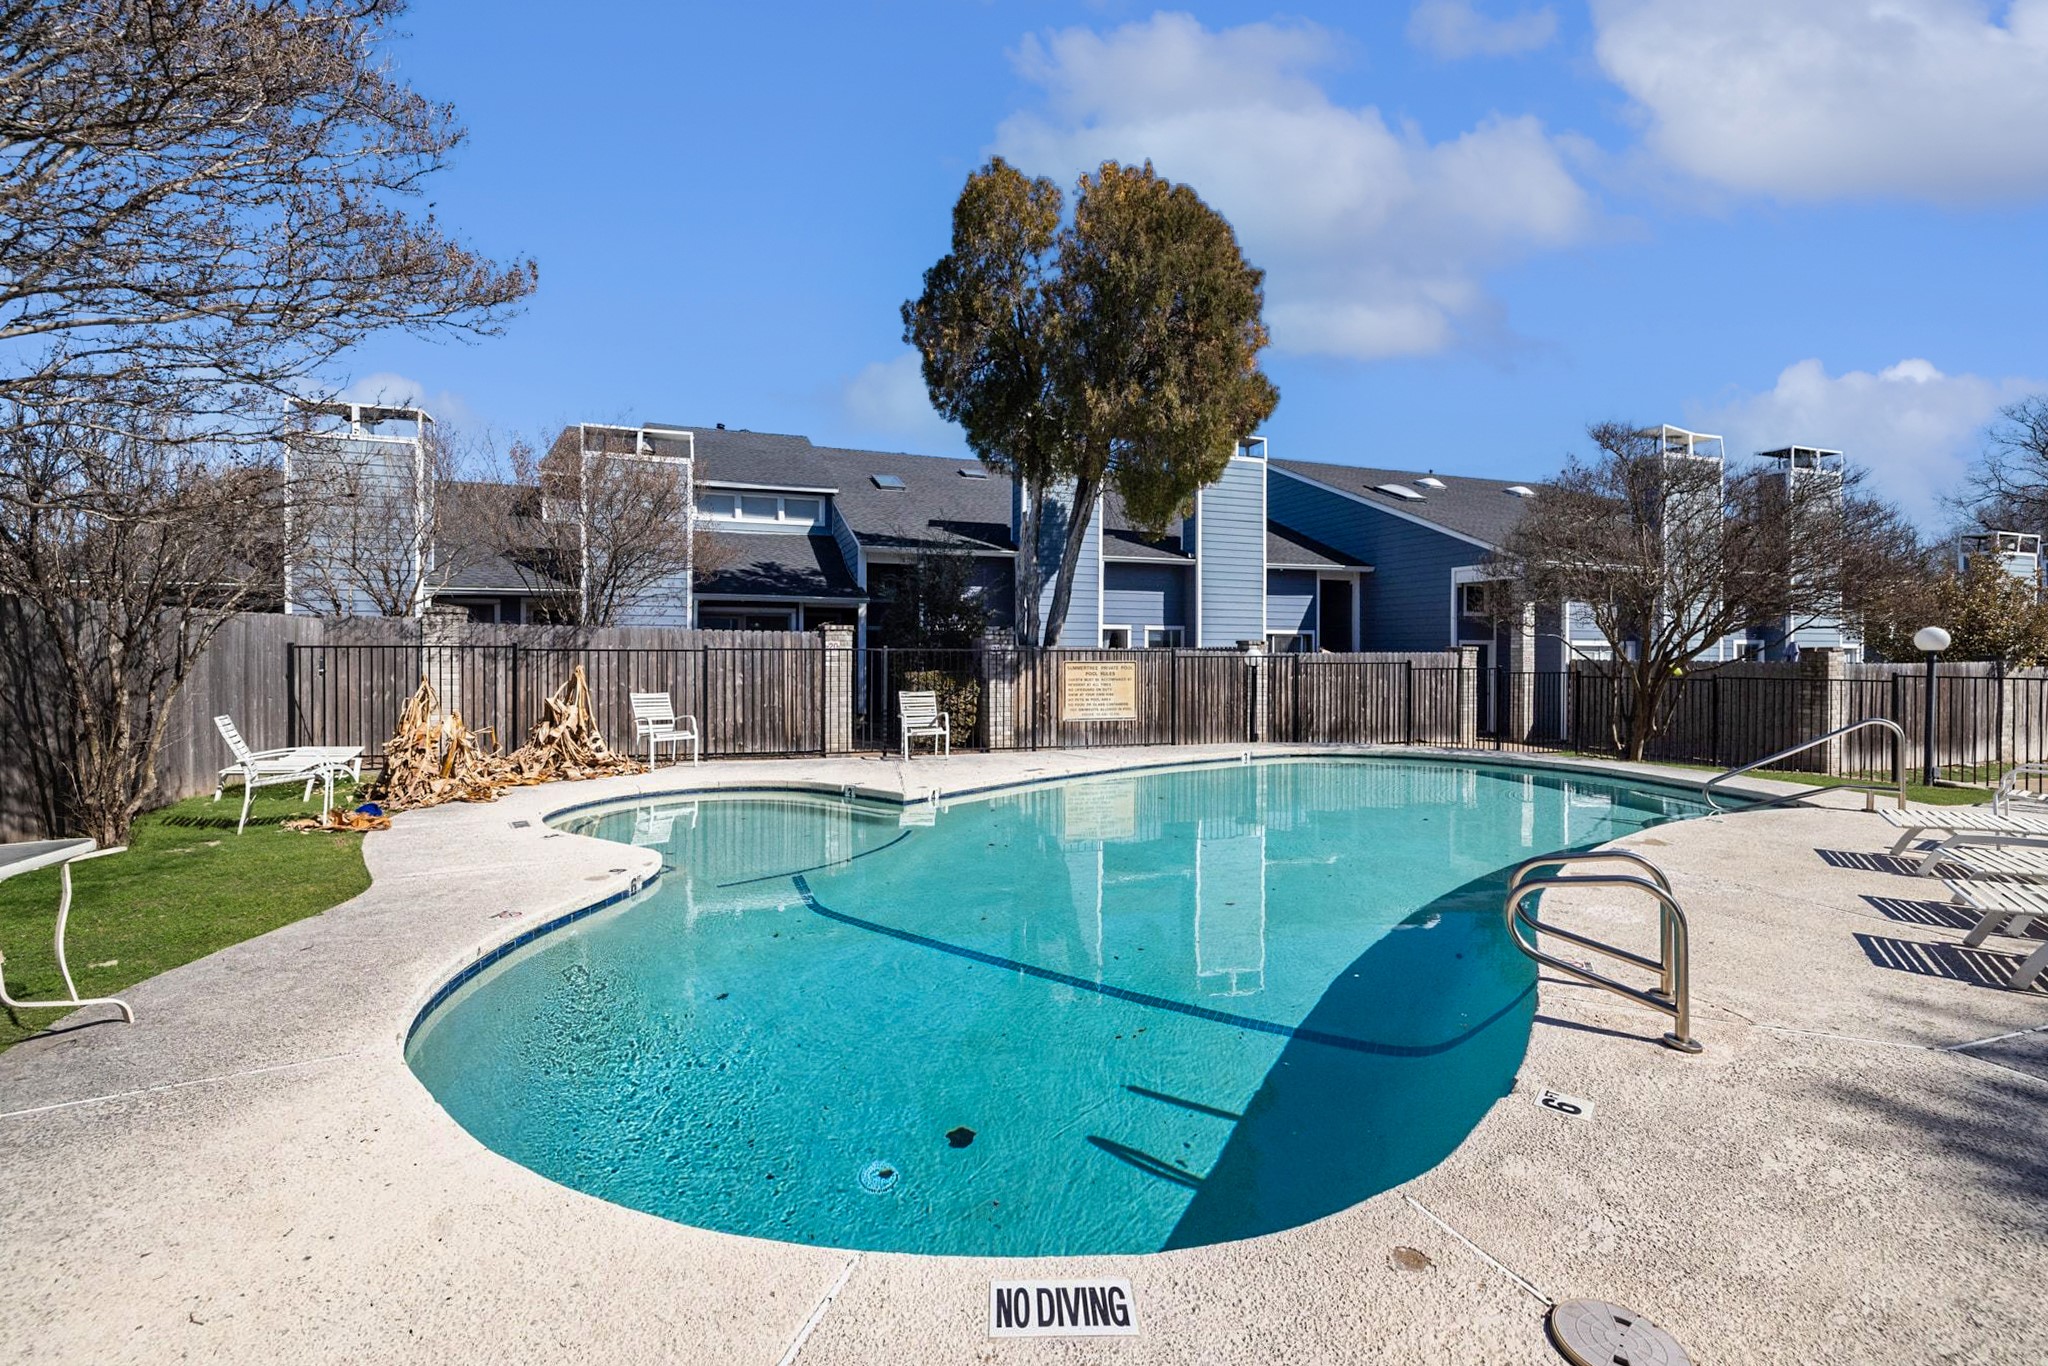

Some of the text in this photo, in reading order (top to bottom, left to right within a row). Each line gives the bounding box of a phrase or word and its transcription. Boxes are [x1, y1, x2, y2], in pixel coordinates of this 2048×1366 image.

[1542, 1098, 1582, 1115] 6
[996, 1286, 1131, 1328] NO DIVING
